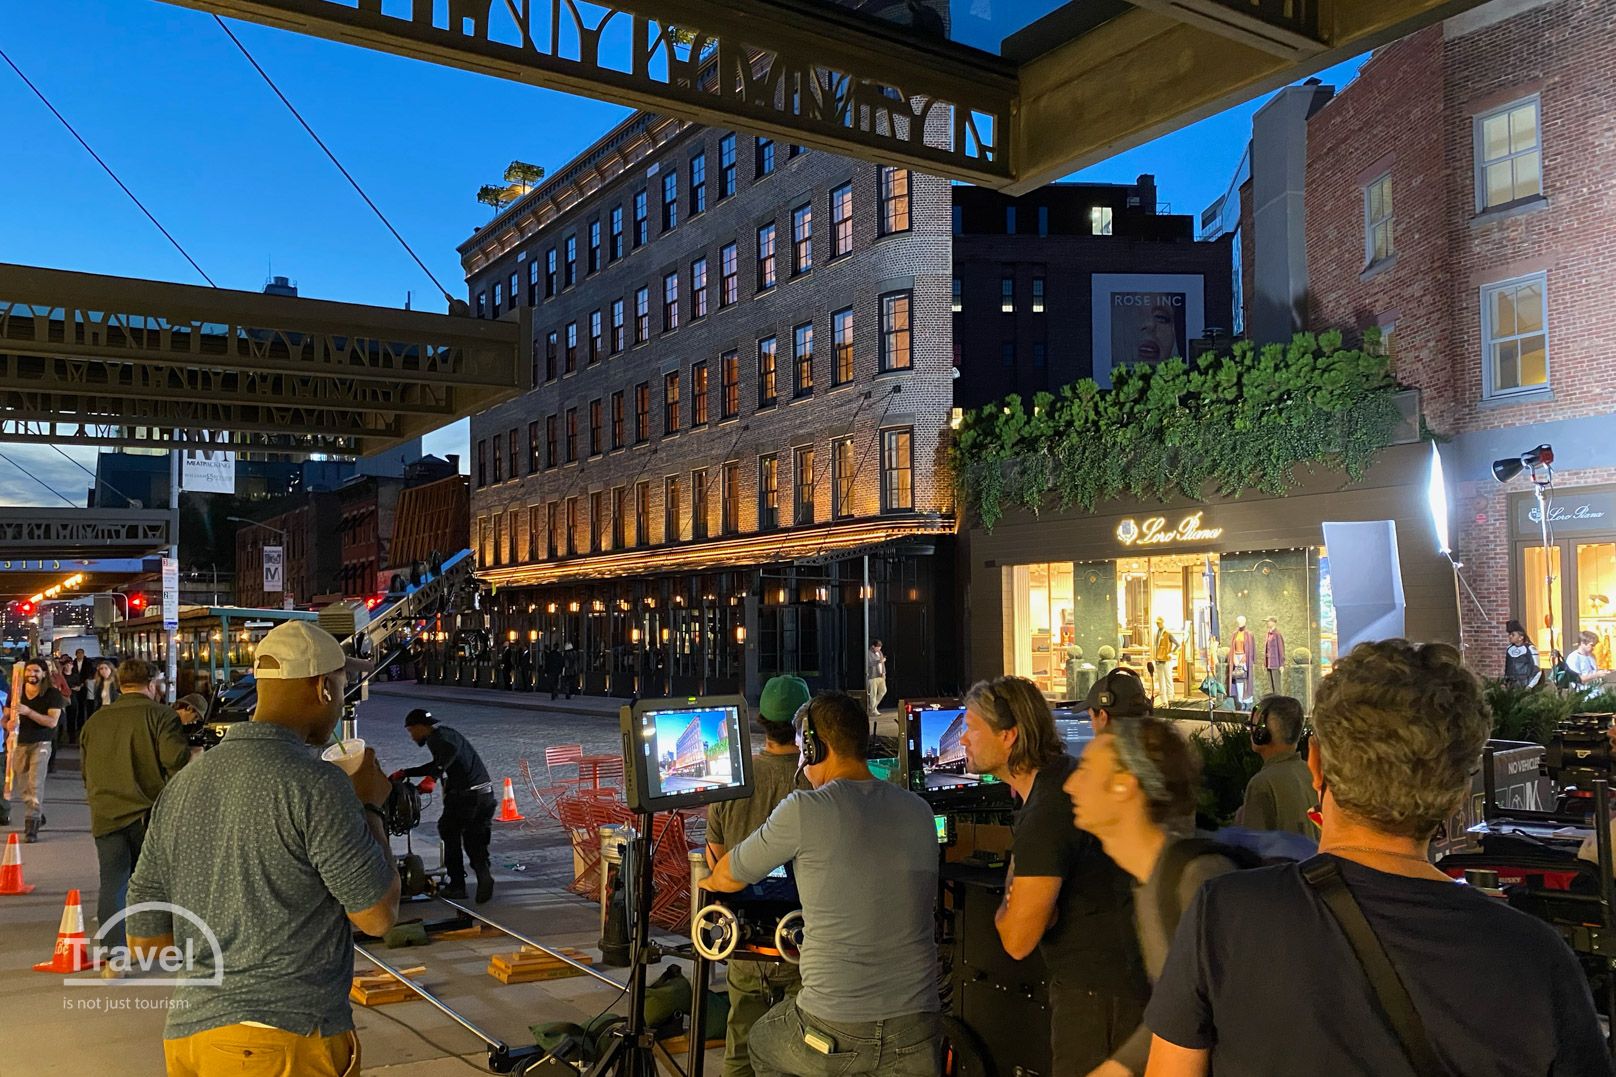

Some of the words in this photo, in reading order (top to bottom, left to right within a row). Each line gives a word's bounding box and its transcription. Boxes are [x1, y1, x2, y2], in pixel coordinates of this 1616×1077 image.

[1114, 295, 1151, 306] ROSE
[1156, 295, 1182, 306] INC
[1547, 506, 1574, 521] Loro
[1573, 503, 1606, 519] Piana
[1136, 516, 1177, 544] Loro
[1175, 511, 1223, 541] Piana
[1508, 761, 1518, 775] NO
